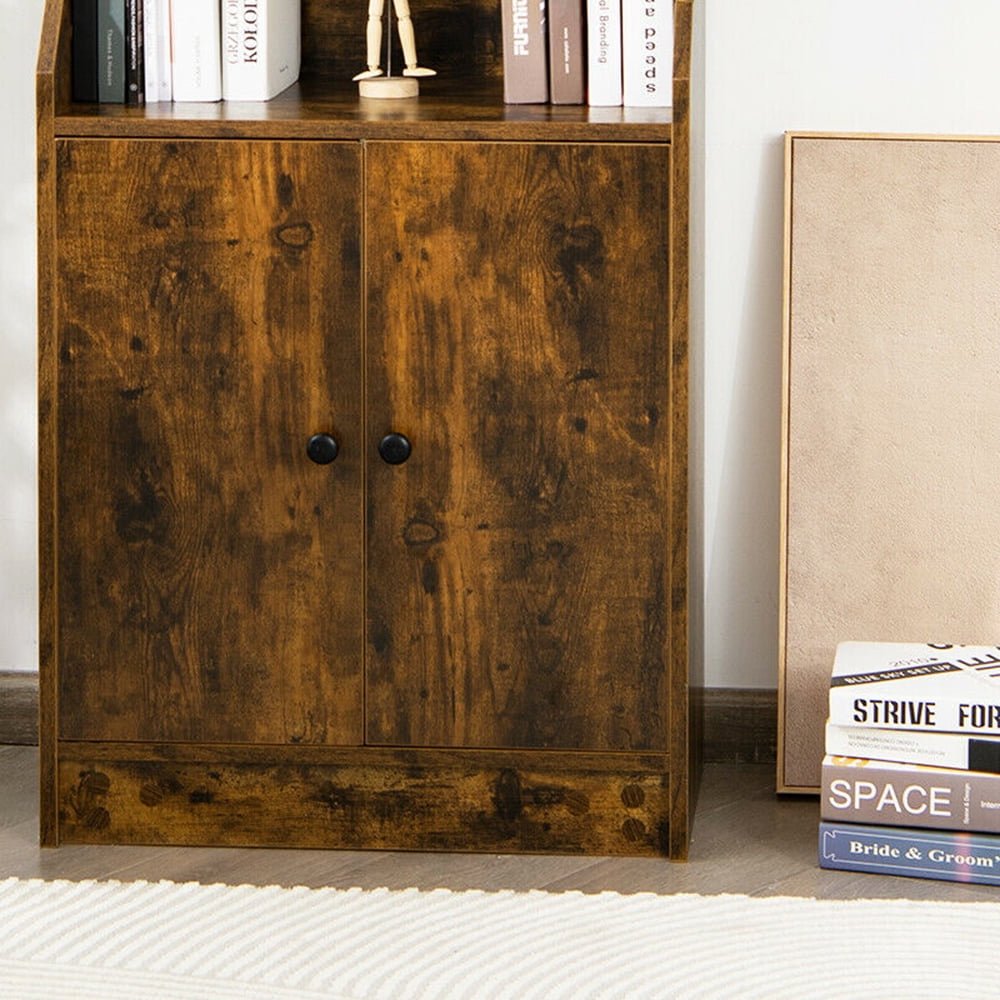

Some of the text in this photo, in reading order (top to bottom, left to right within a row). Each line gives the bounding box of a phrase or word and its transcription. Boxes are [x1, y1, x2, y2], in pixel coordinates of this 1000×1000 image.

[598, 15, 609, 64] Branding
[645, 28, 656, 93] speed
[853, 698, 937, 727] STRIVE
[829, 779, 952, 817] SPACE
[850, 840, 900, 858] Bride
[905, 847, 923, 860] &
